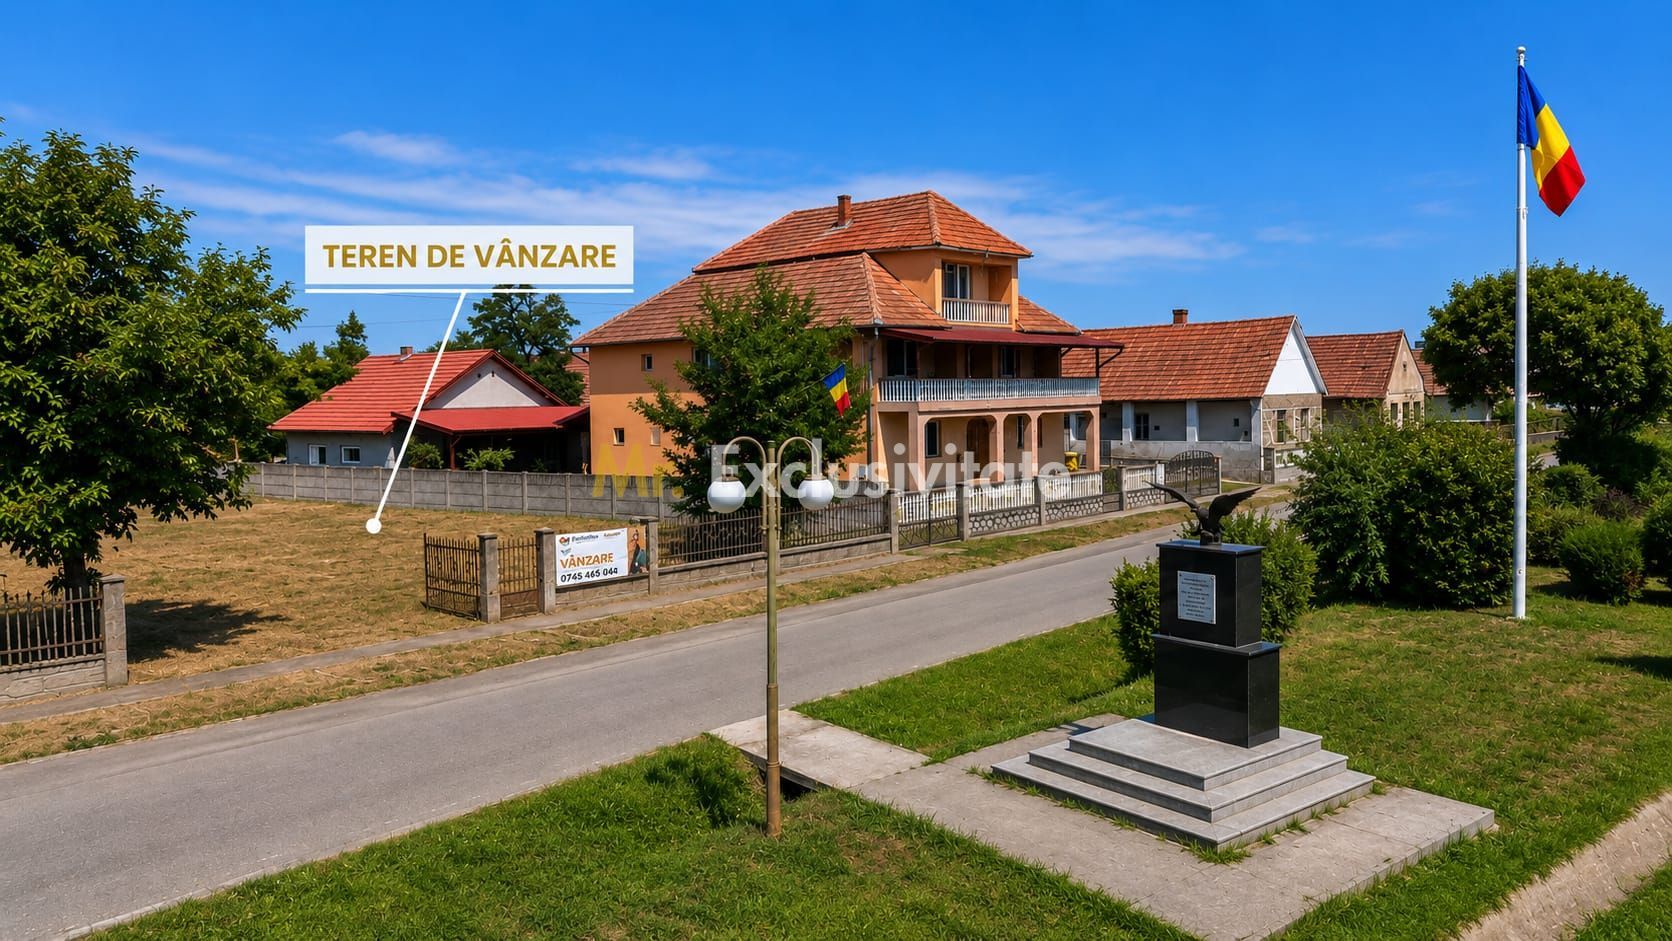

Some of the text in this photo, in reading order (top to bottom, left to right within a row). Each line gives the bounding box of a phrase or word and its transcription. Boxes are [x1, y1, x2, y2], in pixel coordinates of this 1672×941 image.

[560, 553, 614, 568] VÂNZARE
[560, 572, 583, 583] 0745
[585, 569, 601, 579] 465
